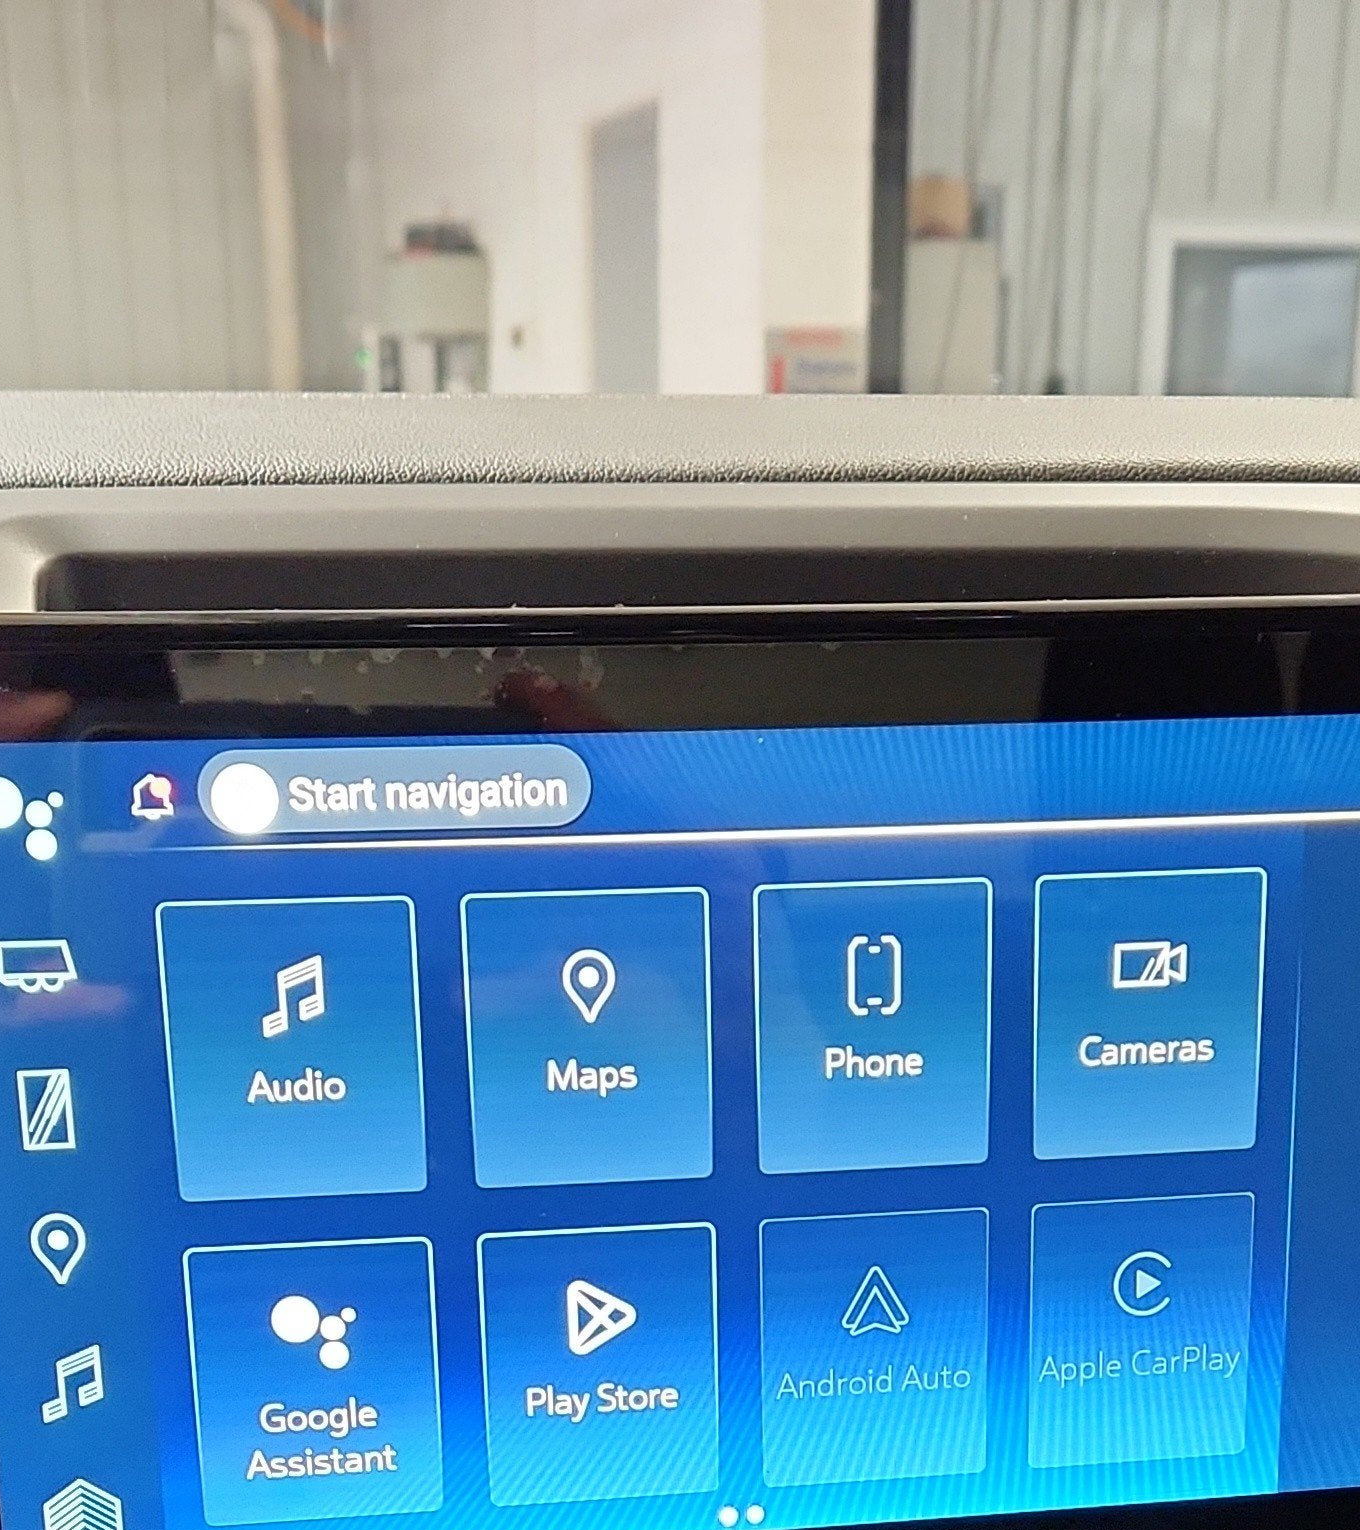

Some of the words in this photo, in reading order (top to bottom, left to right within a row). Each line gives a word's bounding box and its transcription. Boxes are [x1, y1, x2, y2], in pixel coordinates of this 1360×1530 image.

[287, 775, 378, 813] Start
[385, 772, 570, 817] navigation
[823, 1044, 925, 1080] Phone
[1077, 1034, 1216, 1068] Cameras
[246, 1066, 347, 1104] Audio
[545, 1058, 639, 1099] Maps
[775, 1364, 893, 1402] Android
[900, 1360, 973, 1393] Auto
[1038, 1349, 1124, 1389] Apple
[1130, 1343, 1242, 1381] CarPlay
[259, 1395, 379, 1439] Google
[525, 1384, 590, 1424] Play
[595, 1381, 680, 1414] Store
[244, 1442, 399, 1481] Assistant
